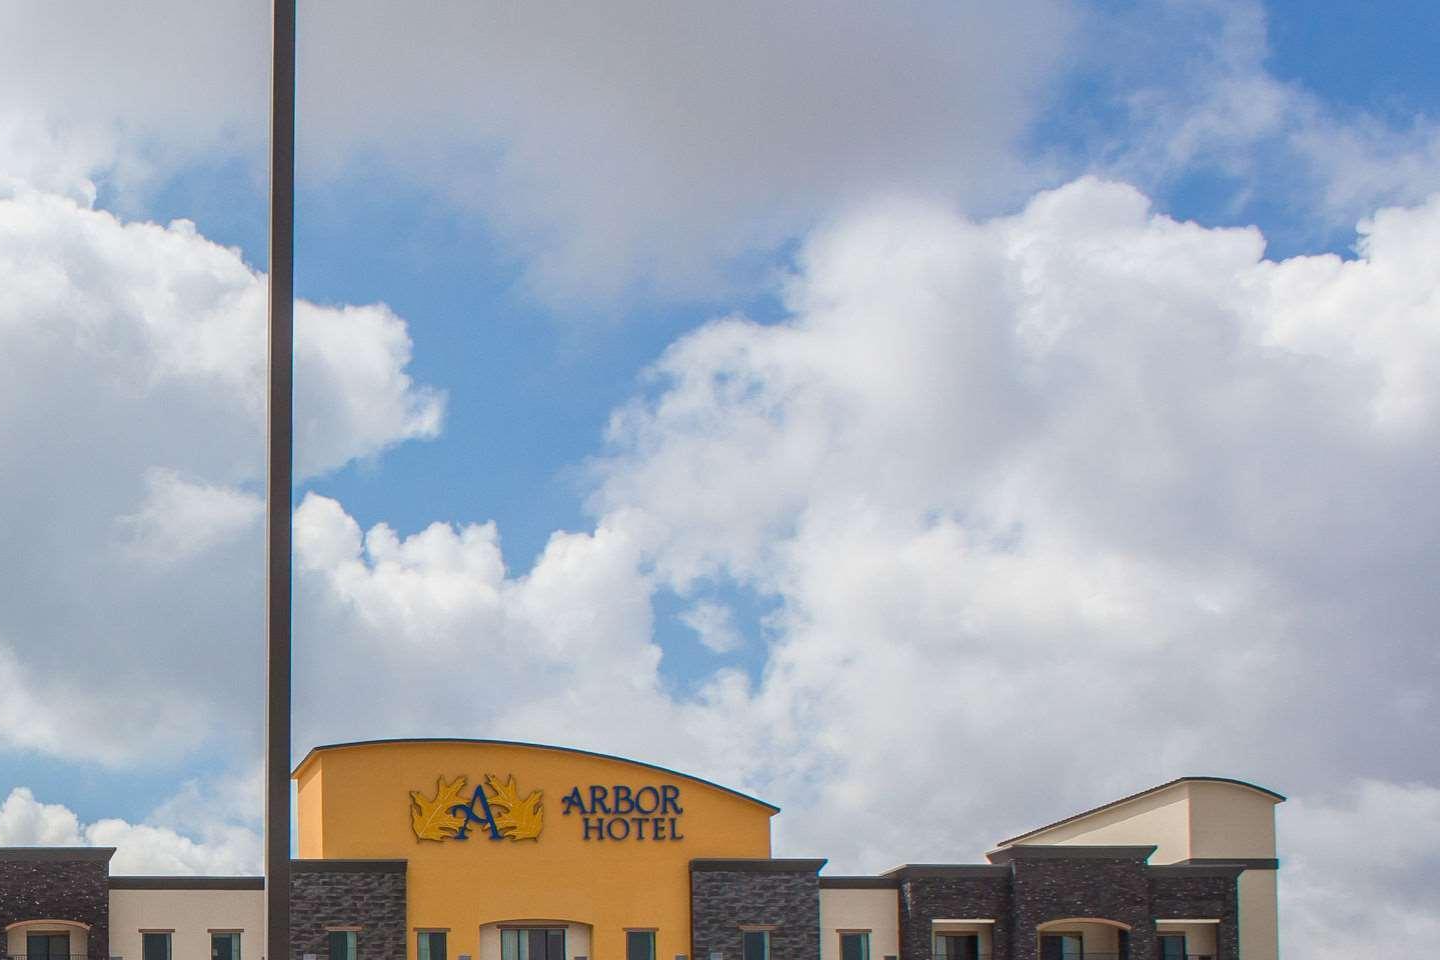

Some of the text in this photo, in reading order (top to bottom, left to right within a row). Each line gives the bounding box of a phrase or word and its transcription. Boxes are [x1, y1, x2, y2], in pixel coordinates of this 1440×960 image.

[450, 784, 503, 841] A
[562, 785, 684, 816] ARBOR
[583, 816, 684, 841] HOTEL
